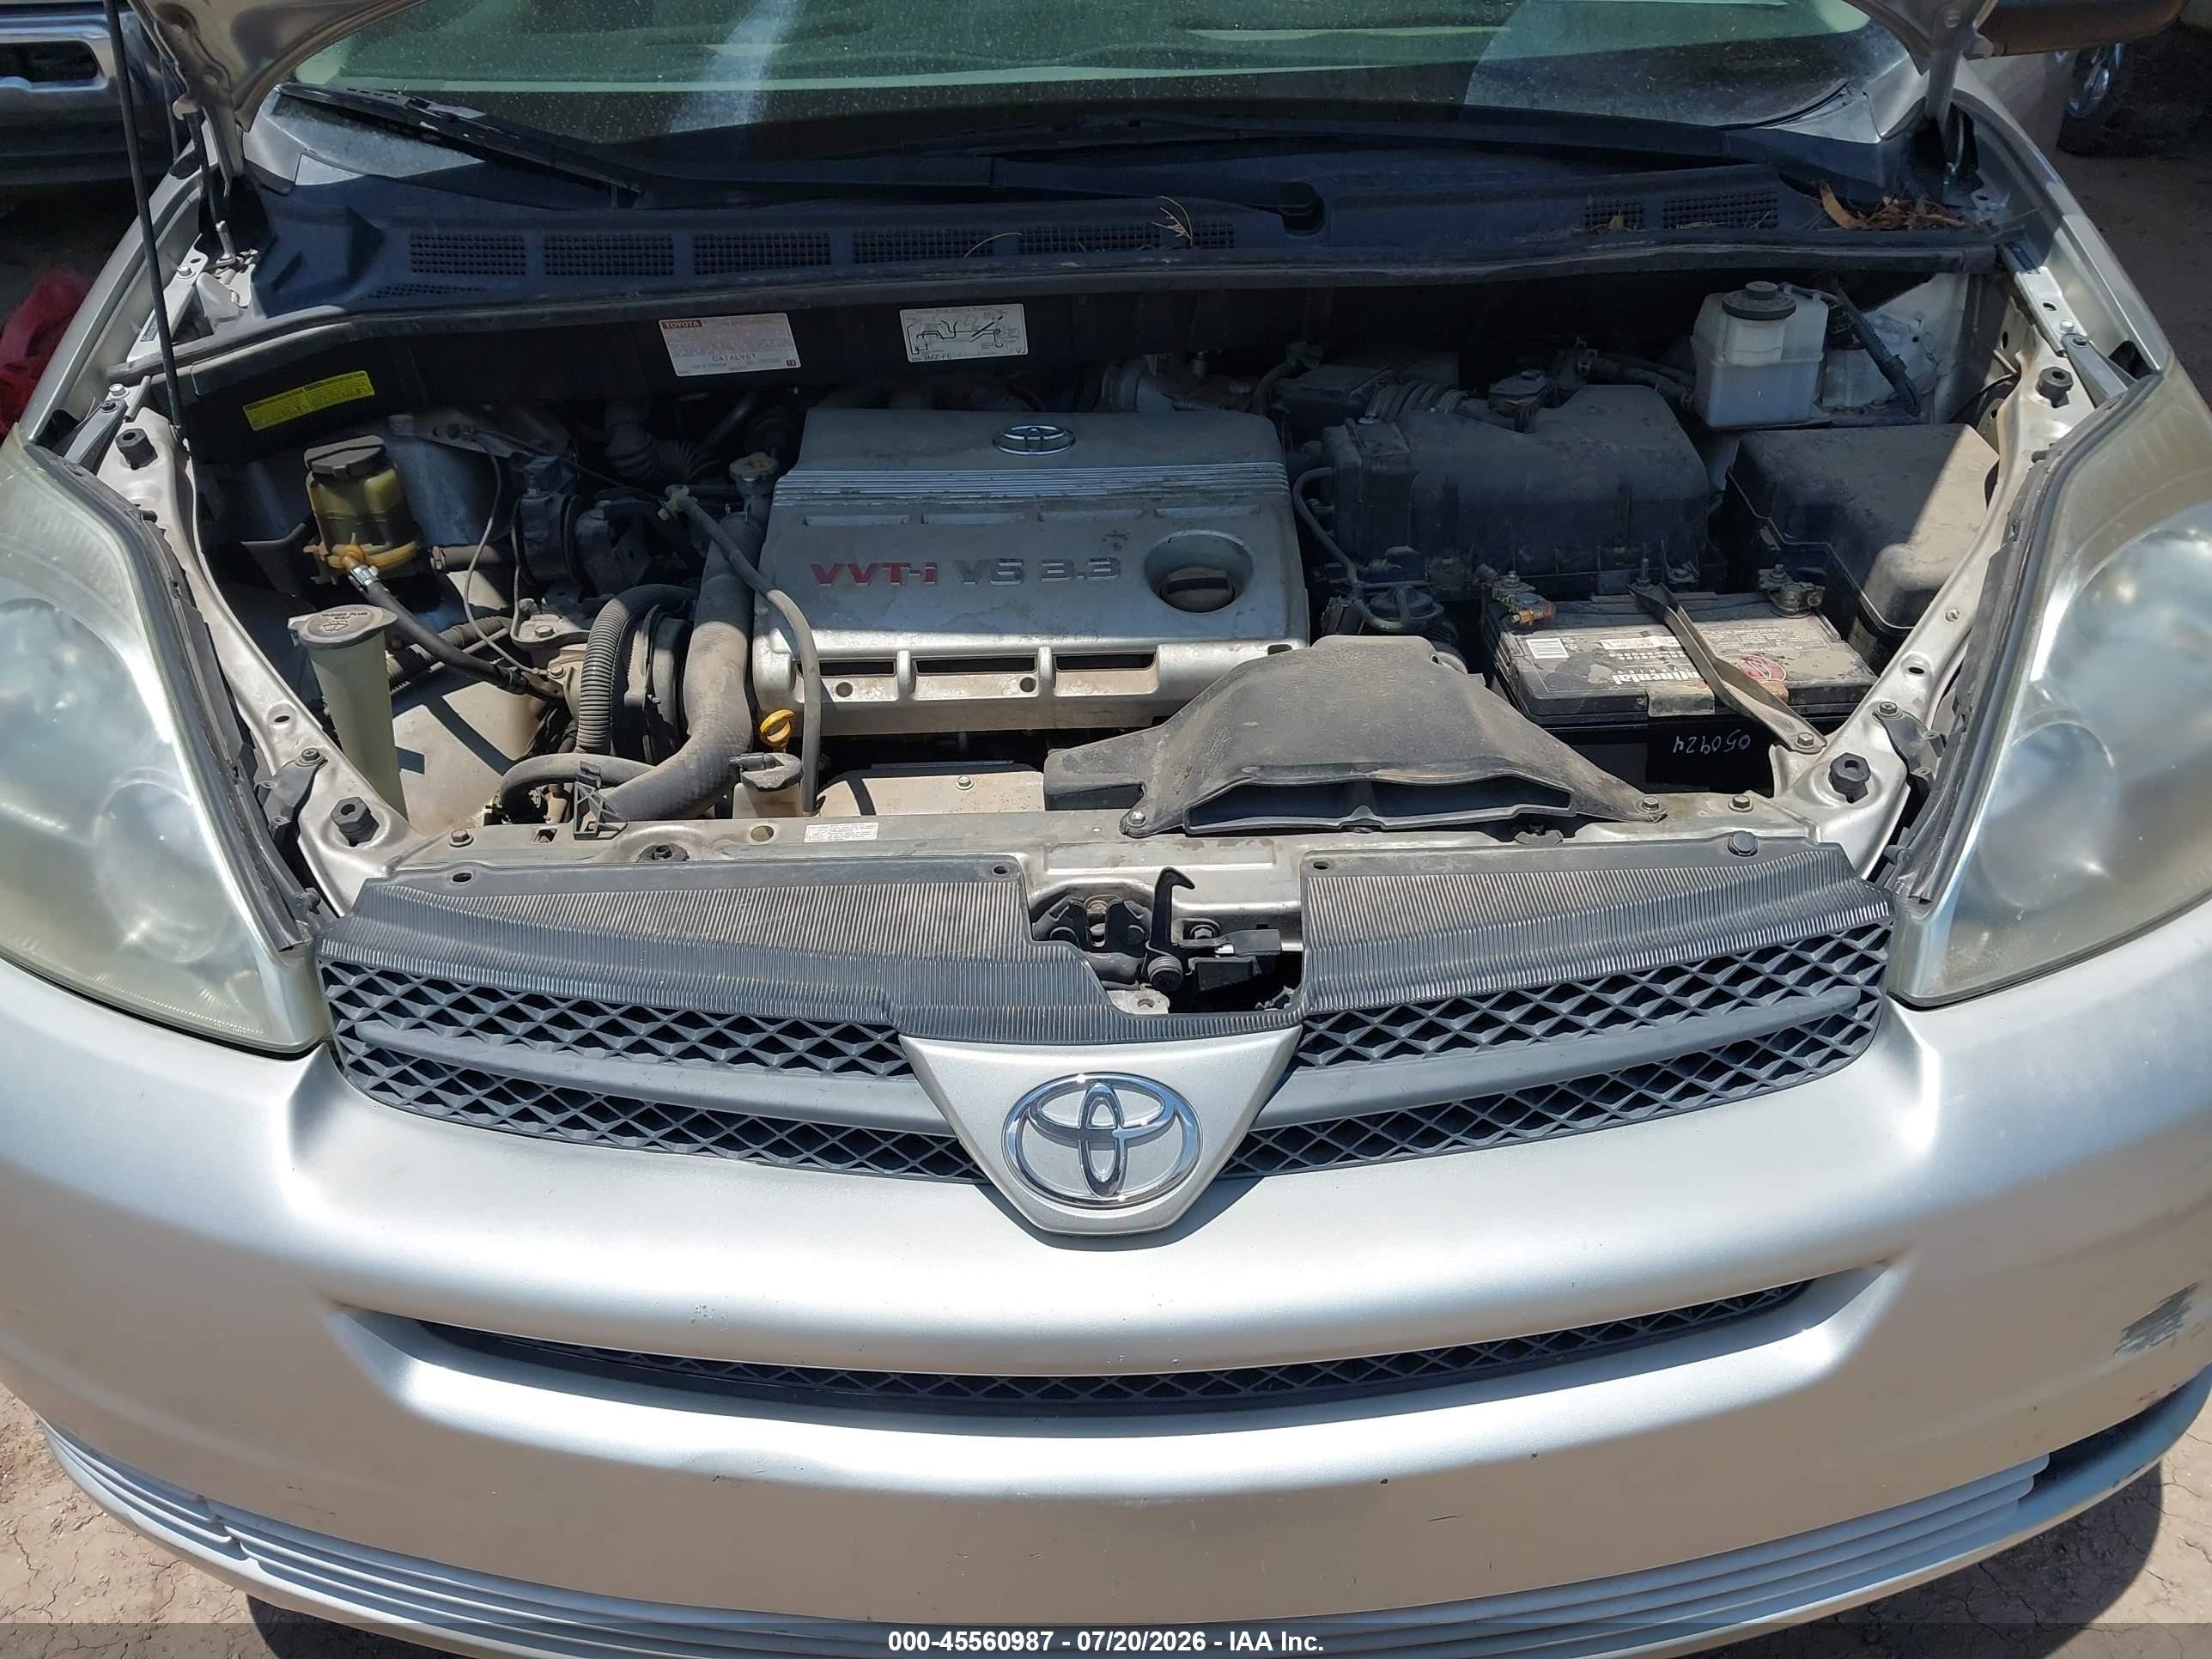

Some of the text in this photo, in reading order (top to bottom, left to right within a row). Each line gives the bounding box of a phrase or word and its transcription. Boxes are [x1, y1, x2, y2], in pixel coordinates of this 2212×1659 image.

[665, 320, 701, 329] TOYOTA
[712, 353, 757, 362] CATALYST
[811, 556, 1121, 586] VVT-i V6 3.3
[1611, 671, 1702, 685] ntinental
